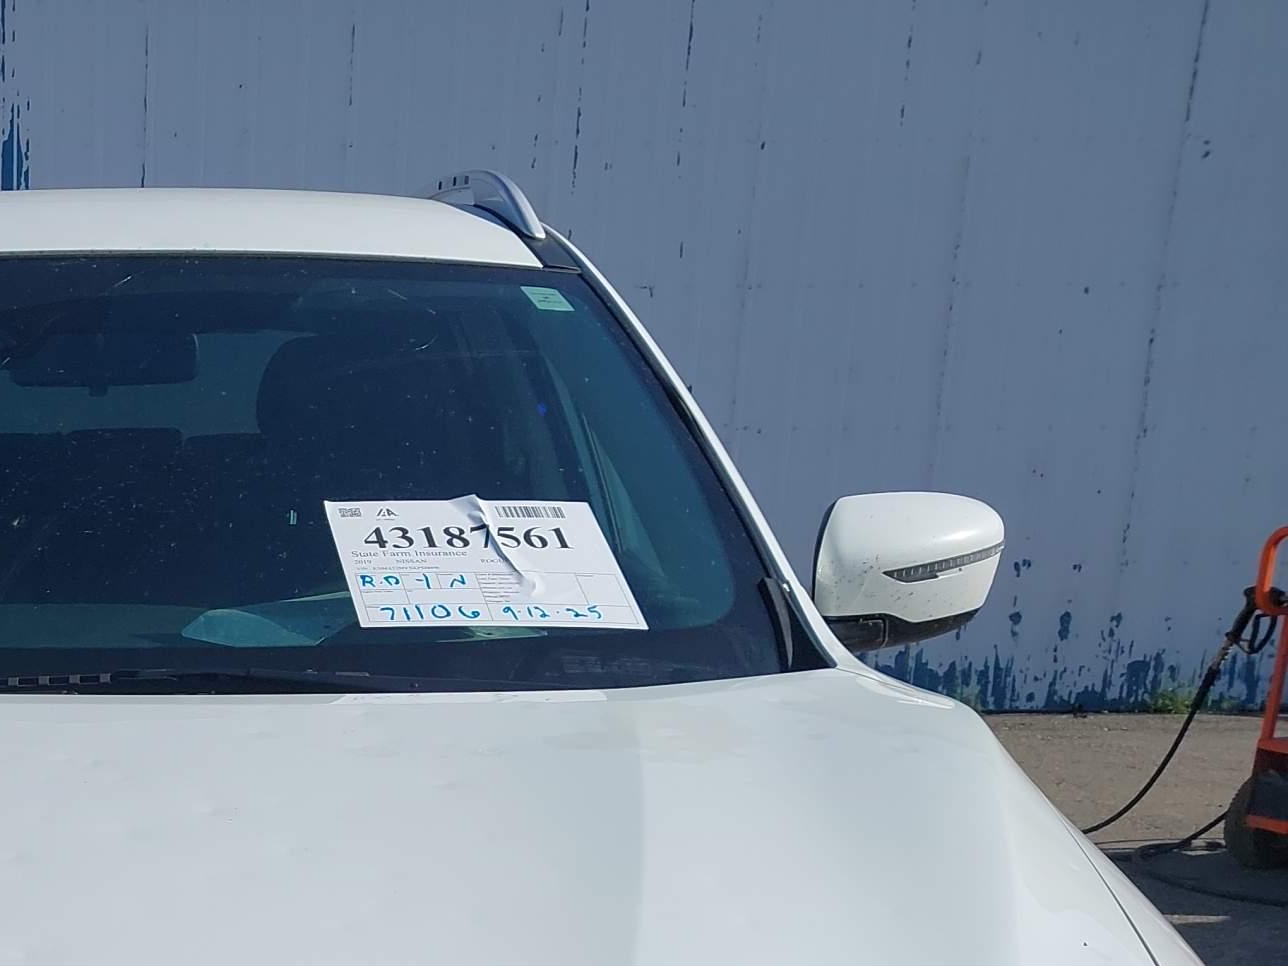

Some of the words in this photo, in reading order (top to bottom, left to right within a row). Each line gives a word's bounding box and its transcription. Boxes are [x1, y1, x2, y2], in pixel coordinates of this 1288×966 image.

[363, 525, 575, 550] 43187561
[352, 550, 380, 558] State
[383, 550, 411, 558] Farm
[414, 550, 468, 558] Insurance
[379, 604, 481, 621] 71106
